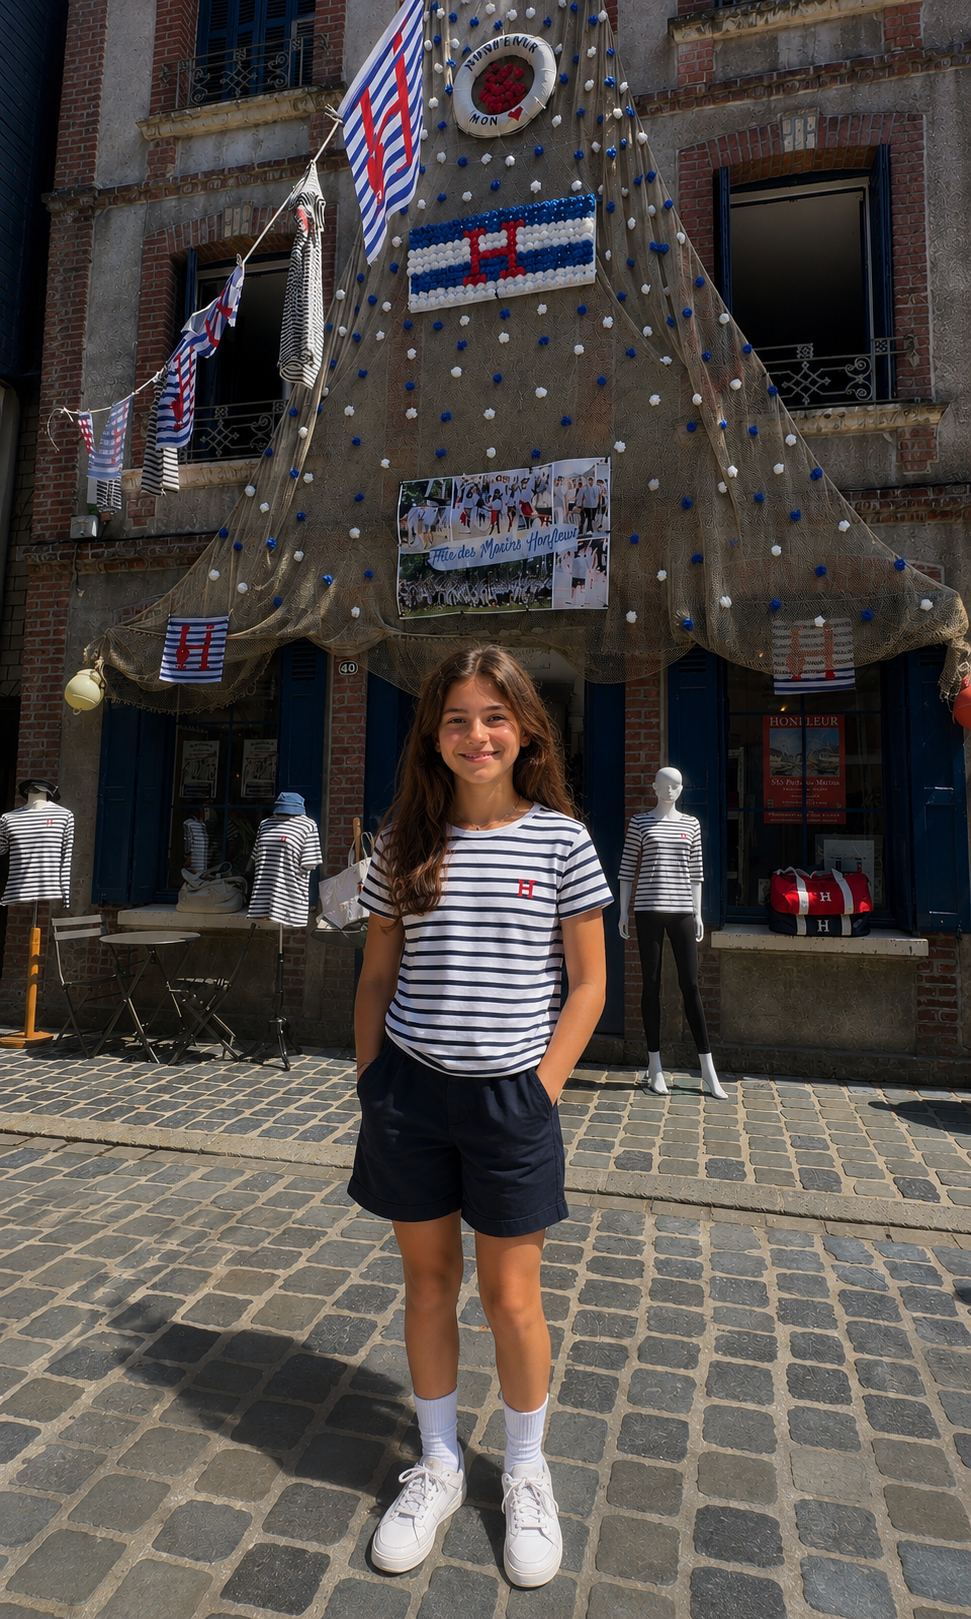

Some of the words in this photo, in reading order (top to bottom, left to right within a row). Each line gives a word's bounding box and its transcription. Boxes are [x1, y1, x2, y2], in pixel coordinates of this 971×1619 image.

[469, 113, 498, 126] MON
[463, 219, 526, 287] H
[457, 544, 476, 559] des
[340, 663, 356, 673] 40
[517, 879, 536, 899] H
[819, 891, 832, 902] H
[816, 919, 830, 932] H
